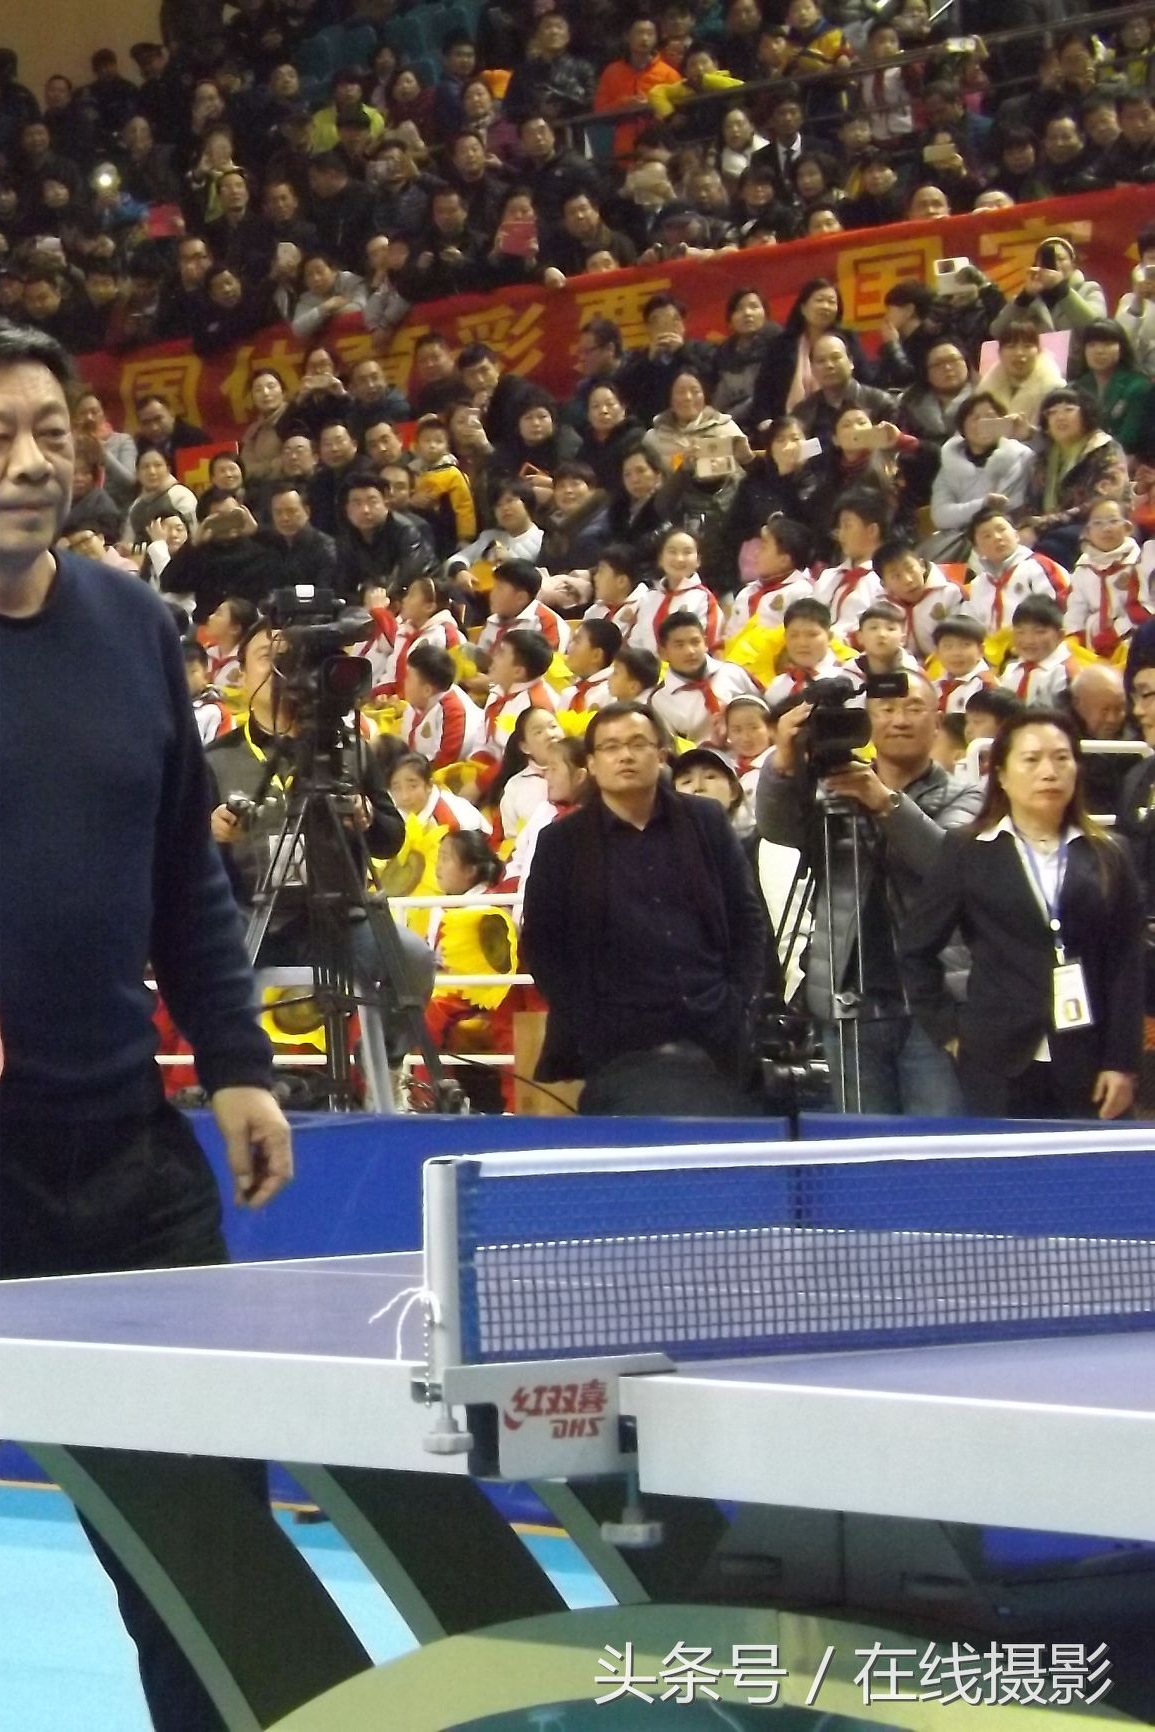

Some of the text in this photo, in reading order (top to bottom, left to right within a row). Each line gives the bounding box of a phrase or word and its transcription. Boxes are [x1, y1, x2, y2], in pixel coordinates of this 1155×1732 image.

[503, 1379, 608, 1431] 红双喜
[550, 1417, 605, 1439] DHS
